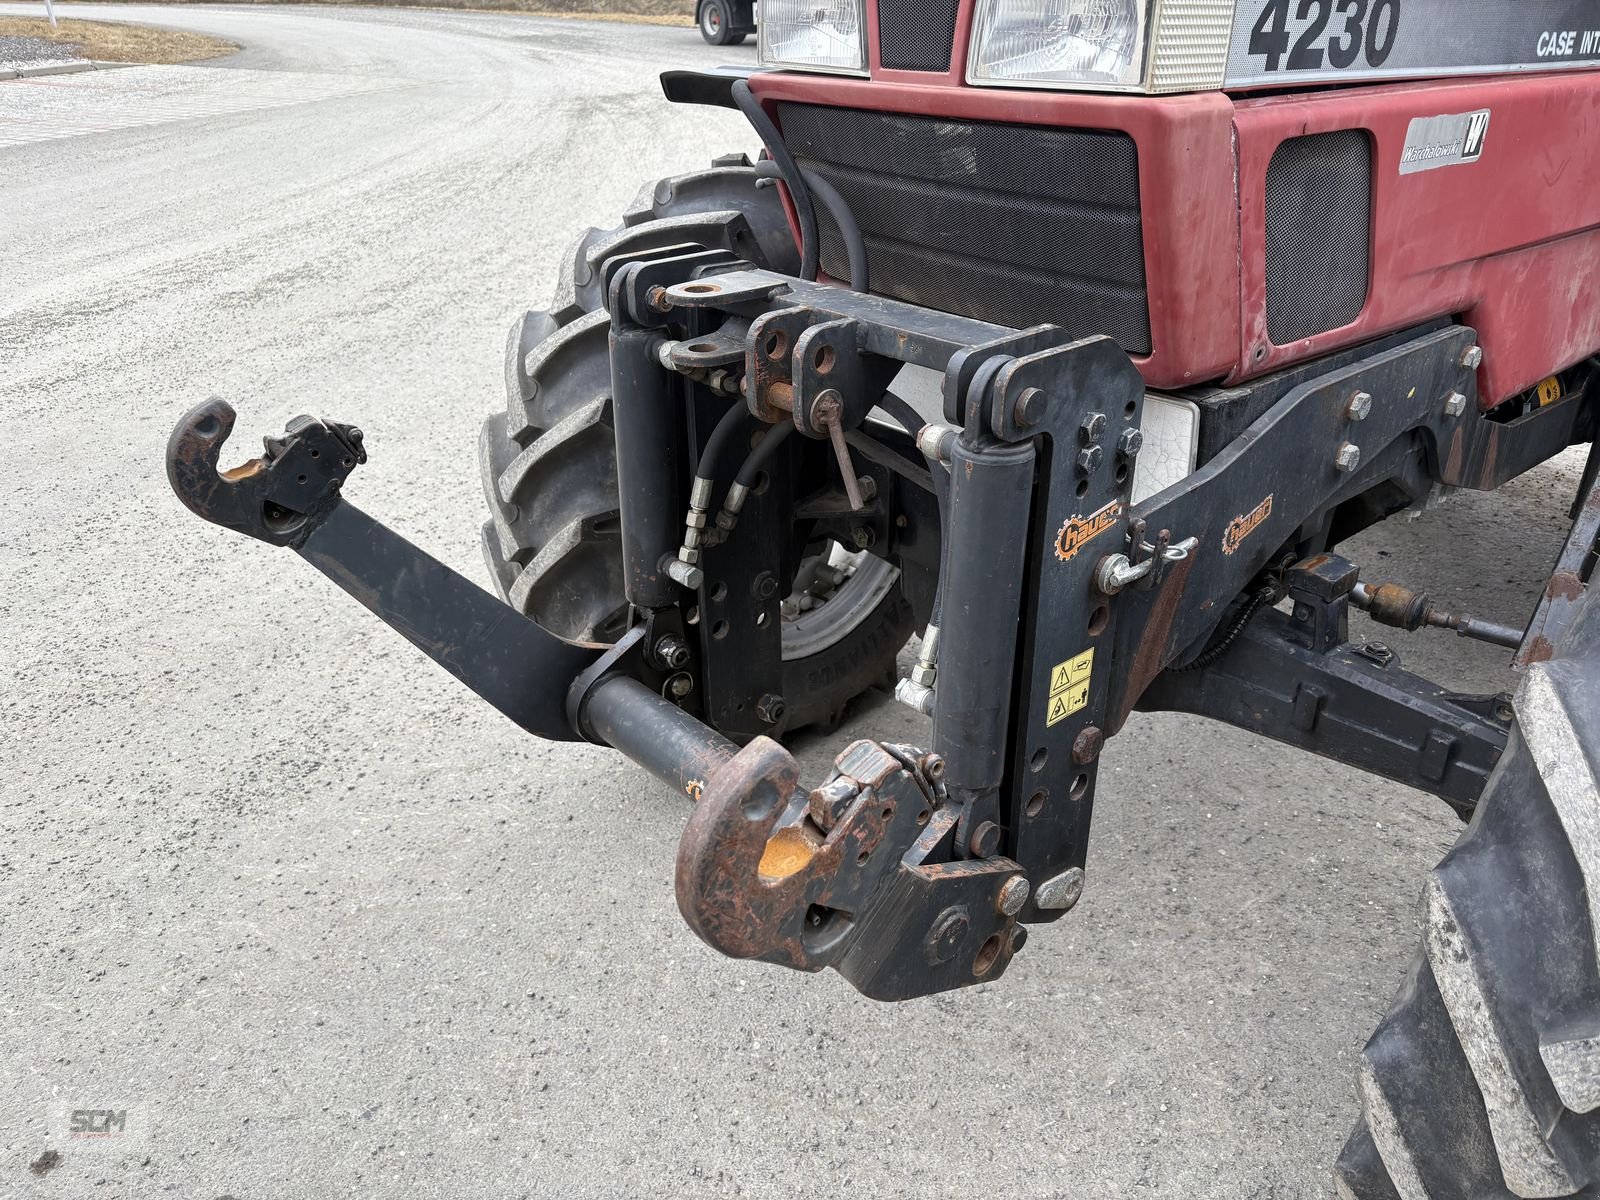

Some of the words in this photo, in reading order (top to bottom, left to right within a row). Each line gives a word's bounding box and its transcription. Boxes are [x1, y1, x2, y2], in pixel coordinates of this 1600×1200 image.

[1248, 0, 1400, 71] 4230
[1536, 31, 1577, 56] CASE
[1579, 31, 1600, 54] INT
[1463, 112, 1489, 154] W
[1402, 138, 1462, 163] Warchalowski
